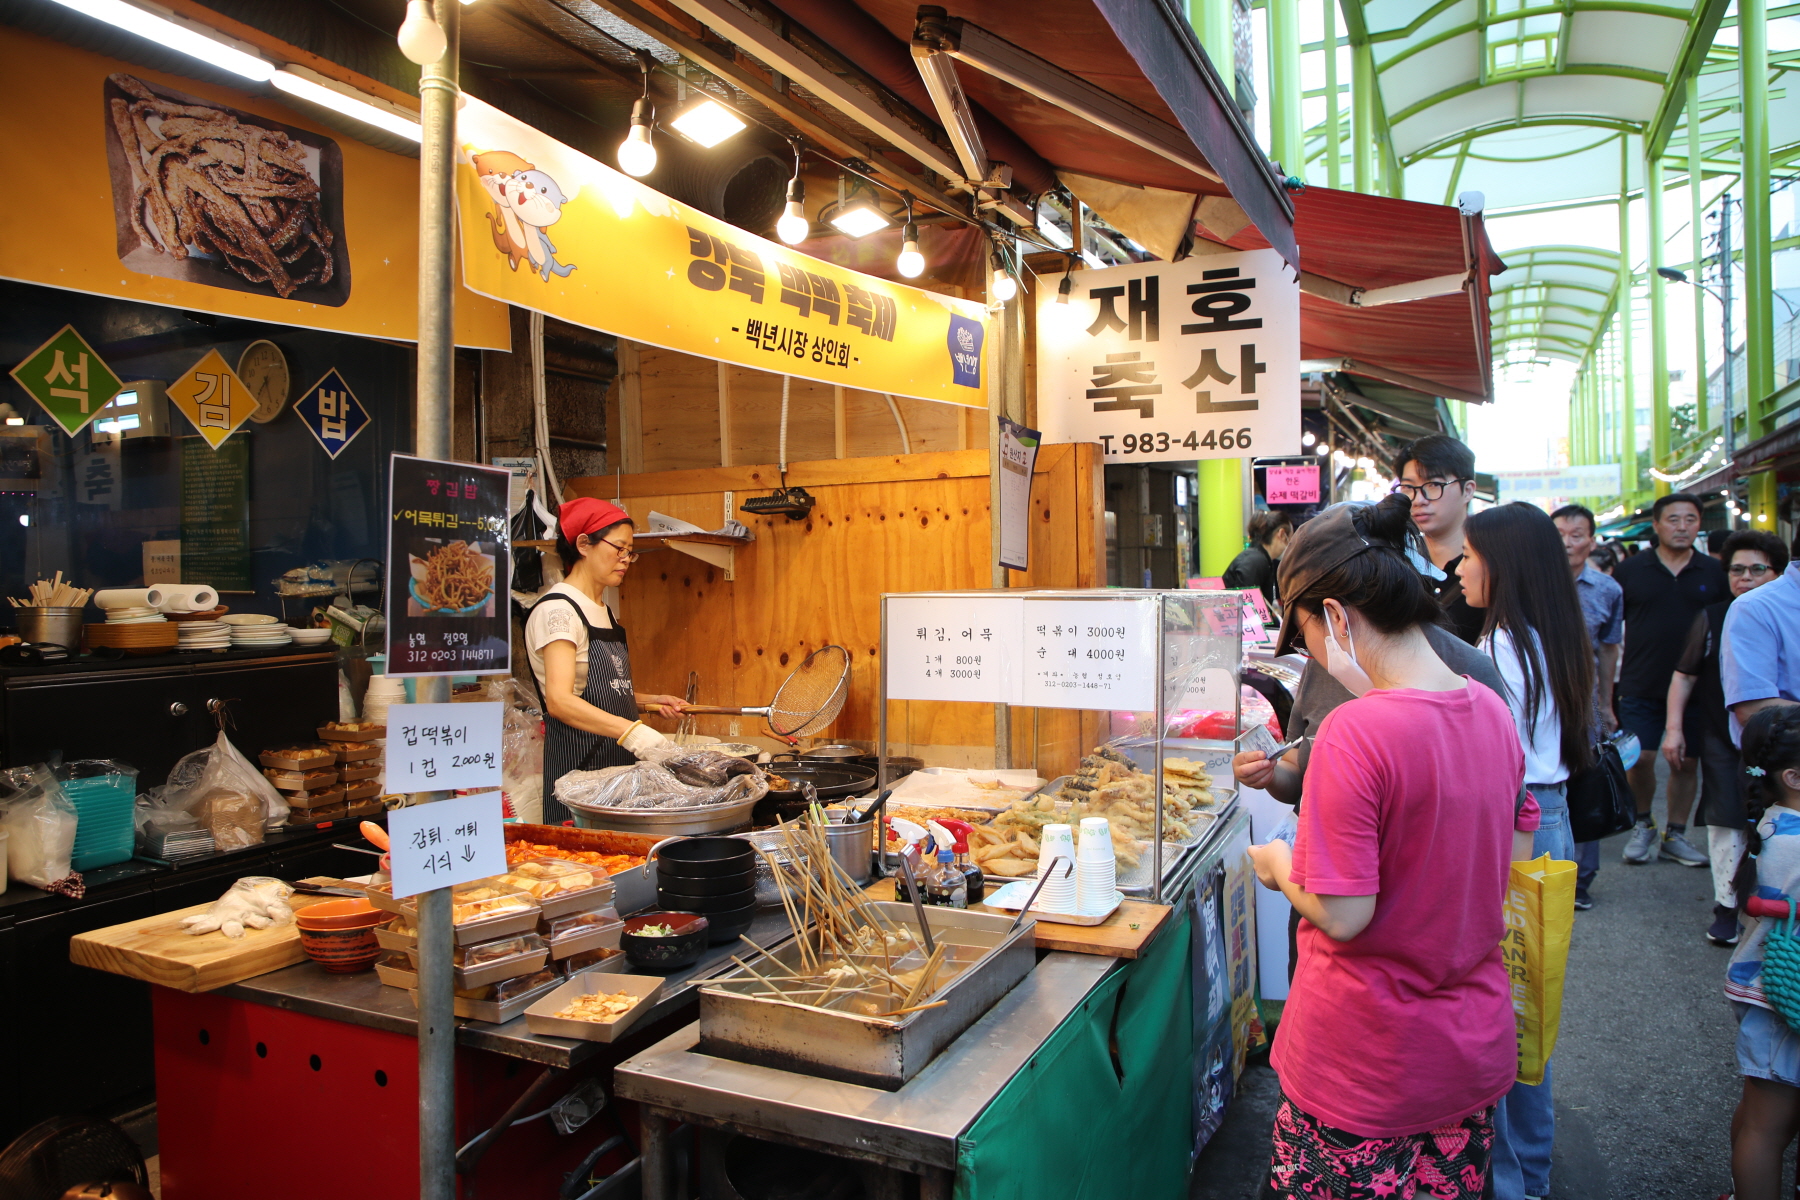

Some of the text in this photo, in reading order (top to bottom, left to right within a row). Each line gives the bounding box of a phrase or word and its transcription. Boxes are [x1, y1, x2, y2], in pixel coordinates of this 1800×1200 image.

[686, 226, 765, 304] 강북
[842, 283, 897, 342] 축제
[746, 318, 808, 358] 백년시장
[812, 336, 850, 368] 상인회
[44, 350, 89, 414] 석
[1086, 344, 1266, 418] 축산
[194, 372, 230, 431] 김
[318, 387, 350, 442] 밥
[1270, 490, 1317, 500] 수제 떡갈비
[1087, 626, 1125, 639] 3000원
[409, 633, 468, 648] 농협 정호영
[407, 649, 494, 662] 312 0203 144871
[956, 655, 981, 665] 800원
[1086, 649, 1125, 661] 4000원
[950, 669, 980, 679] 3000원
[1044, 681, 1111, 689] 312-0203-1448-71
[423, 851, 452, 874] 시식
